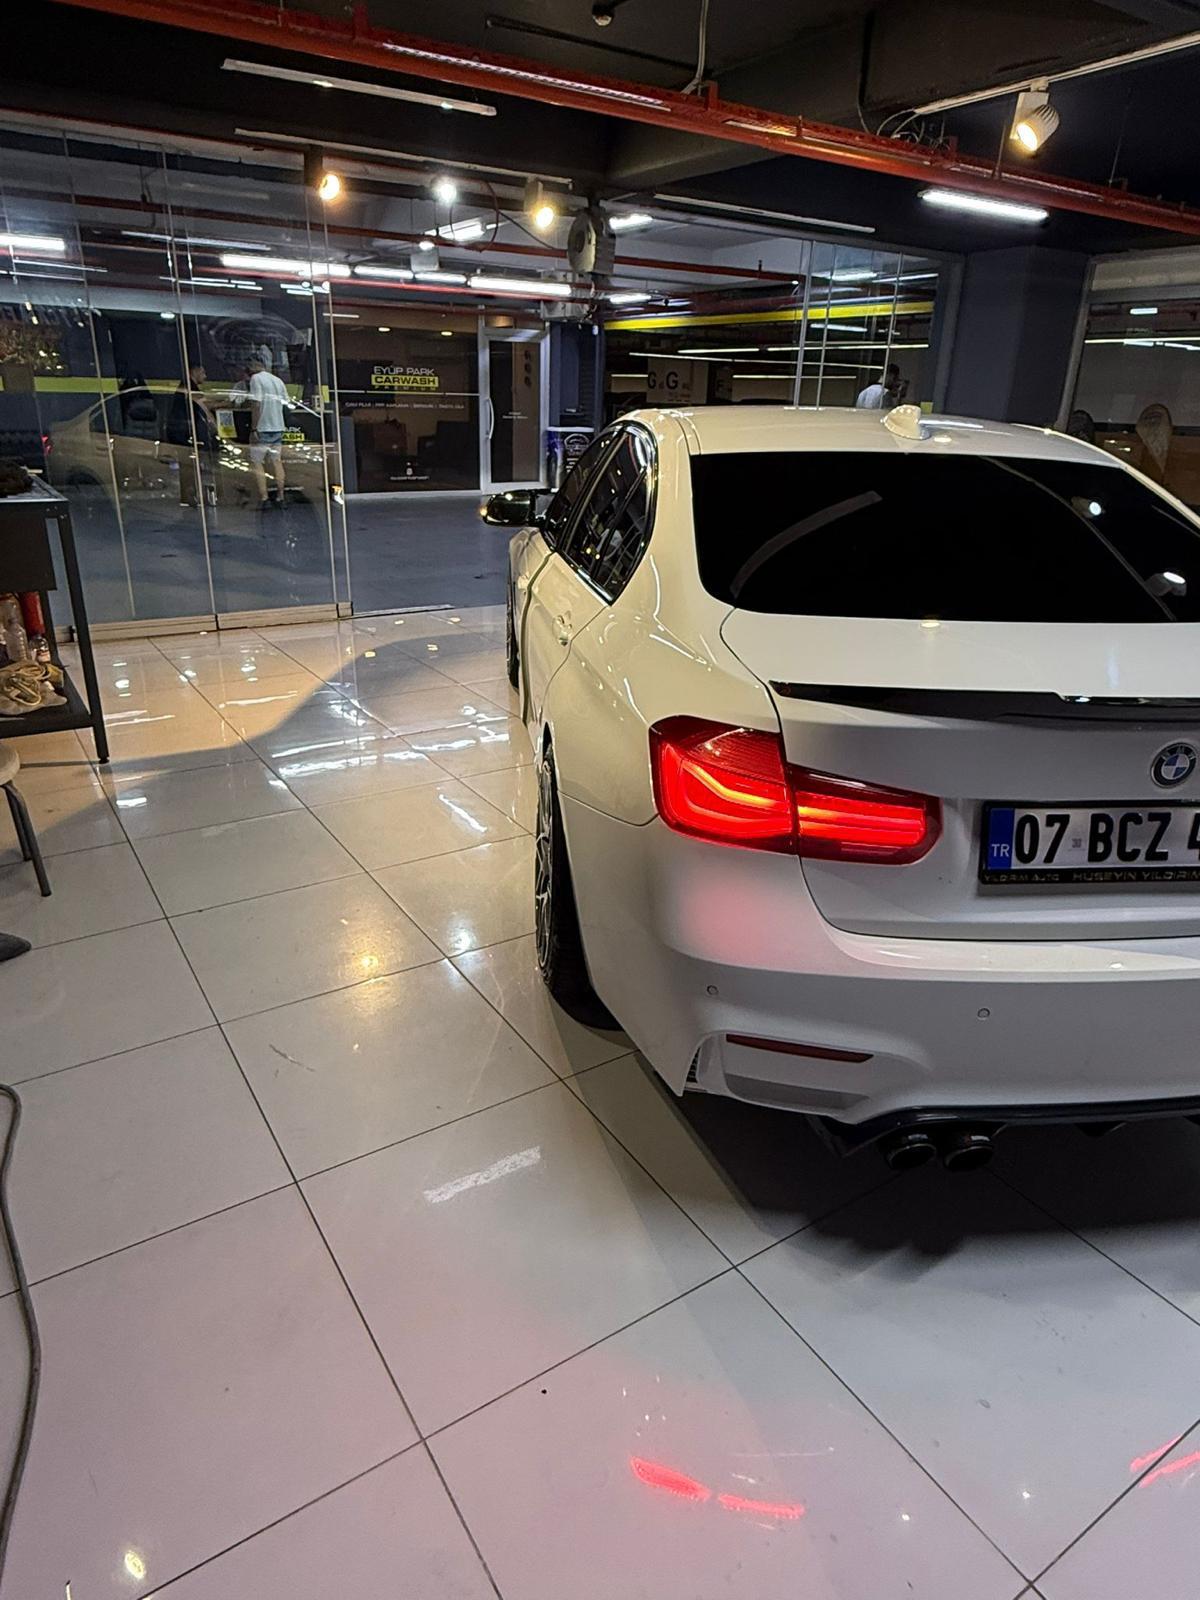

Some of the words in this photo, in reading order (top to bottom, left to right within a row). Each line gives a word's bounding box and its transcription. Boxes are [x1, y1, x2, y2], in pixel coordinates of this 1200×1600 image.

[406, 367, 435, 376] PARK
[374, 376, 436, 385] CARWASH
[991, 843, 1010, 857] TR
[1015, 814, 1070, 864] 07
[1088, 812, 1172, 863] BCZ
